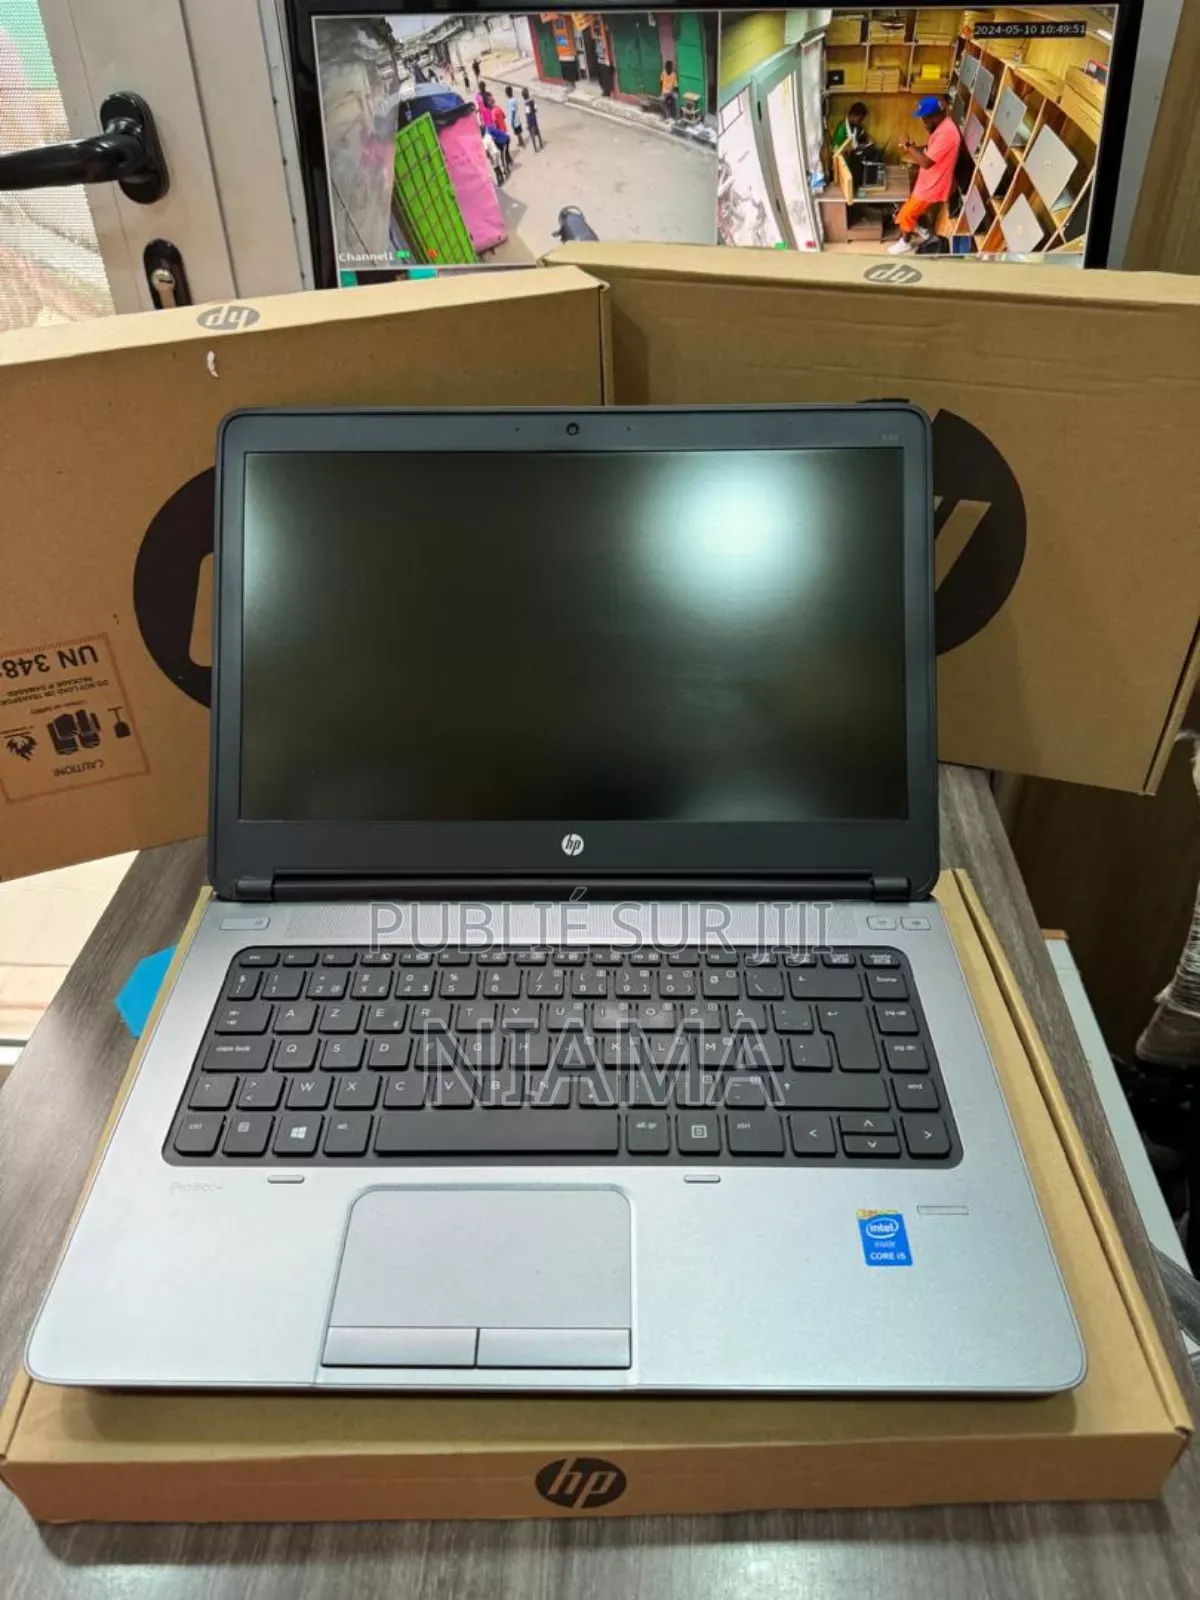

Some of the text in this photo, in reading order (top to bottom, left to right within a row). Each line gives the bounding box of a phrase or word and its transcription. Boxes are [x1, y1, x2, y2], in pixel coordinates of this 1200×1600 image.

[974, 24, 1085, 35] 2024-05-10 10:49:51
[0, 645, 99, 679] UN 348
[563, 833, 583, 856] hp
[285, 1008, 296, 1018] A
[375, 1008, 385, 1017] E
[420, 1008, 431, 1017] R
[555, 1007, 565, 1016] U
[645, 1007, 656, 1016] O
[286, 1043, 297, 1053] Q
[332, 1043, 341, 1053] S
[379, 1043, 389, 1053] D
[704, 1042, 717, 1052] M
[299, 1081, 315, 1092] W
[346, 1081, 357, 1092] X
[395, 1081, 405, 1091] C
[443, 1080, 454, 1090] V
[491, 1080, 500, 1090] B
[869, 1252, 895, 1261] CORE
[545, 1457, 619, 1508] hp
